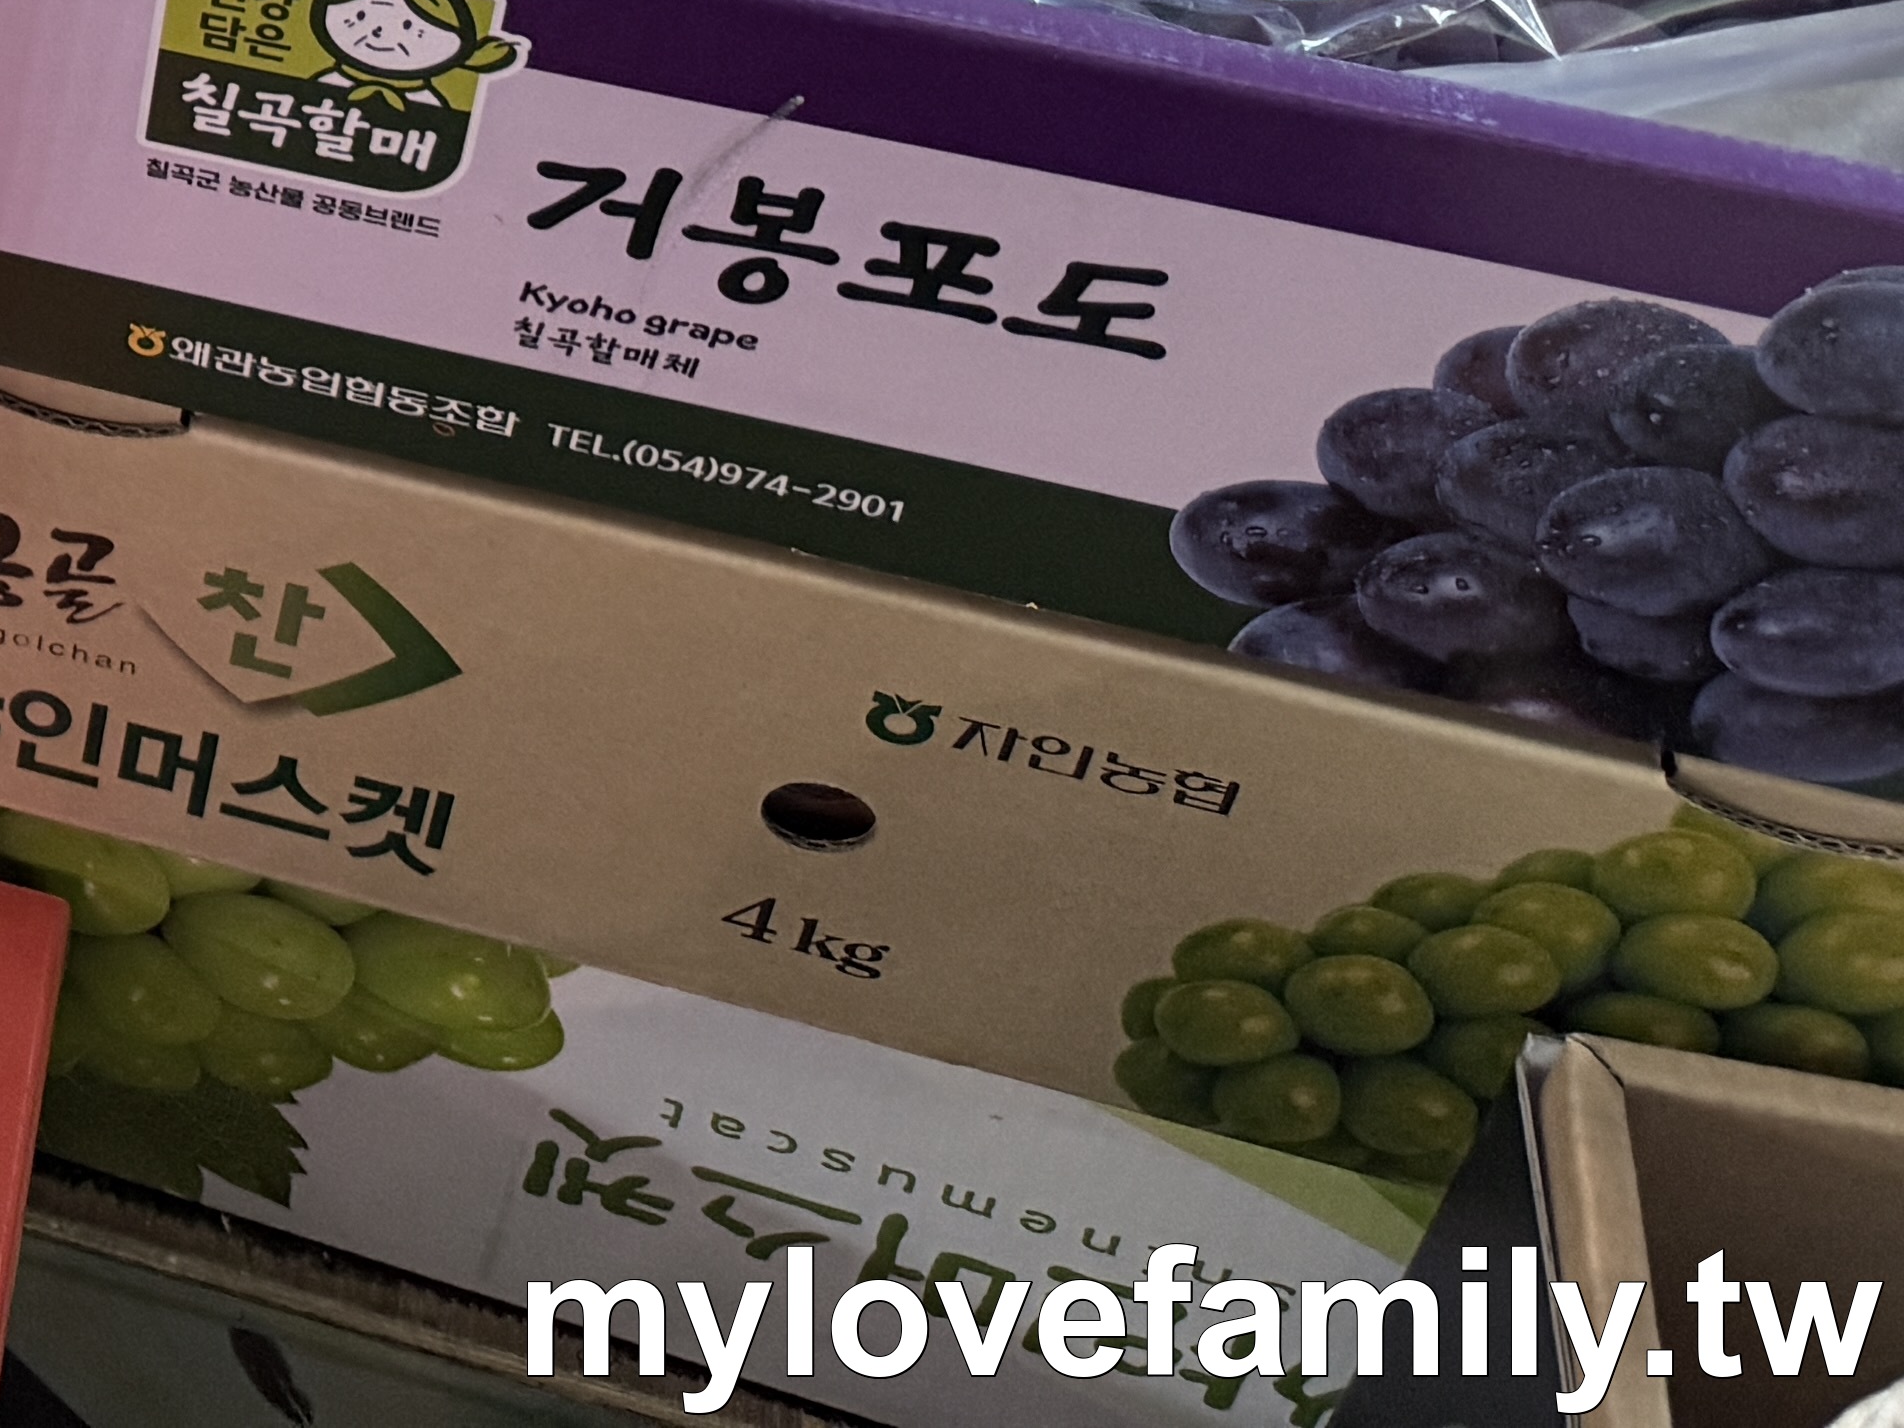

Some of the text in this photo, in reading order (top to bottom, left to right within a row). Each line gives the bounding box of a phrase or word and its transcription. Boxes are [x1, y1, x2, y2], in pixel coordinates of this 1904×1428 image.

[199, 11, 293, 60] 담은
[180, 71, 439, 175] 칠곡할매
[144, 156, 441, 238] 칠곡군 농산물 공동브랜드
[527, 156, 1170, 361] 거봉포도
[512, 317, 702, 381] 칠곡할매체
[519, 281, 760, 356] Kyoho grape
[167, 334, 908, 525] 왜관농업협동조합 TEL.(054)974-2901
[198, 566, 323, 677] 찬
[953, 715, 1239, 818] 자인농협
